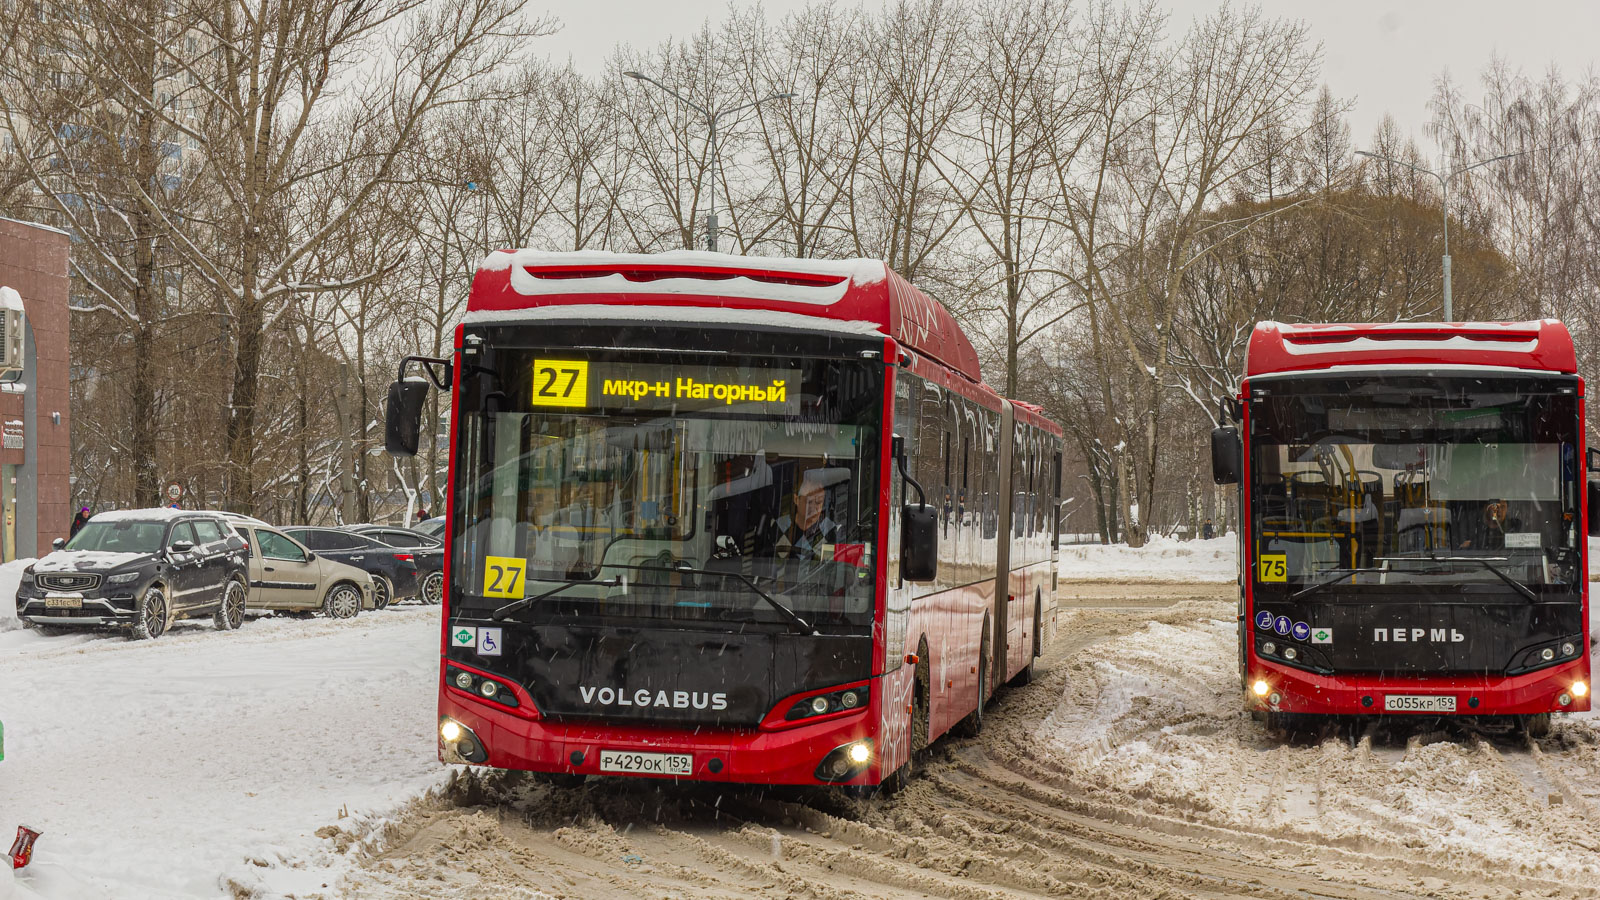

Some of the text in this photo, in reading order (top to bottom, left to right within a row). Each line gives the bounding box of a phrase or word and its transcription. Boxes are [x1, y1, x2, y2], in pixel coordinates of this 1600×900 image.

[538, 367, 580, 398] 27
[602, 377, 786, 405] мкр-н Нагорный
[1262, 560, 1285, 577] 75
[487, 565, 522, 594] 27
[1374, 628, 1465, 642] ПЕРМЬ
[579, 686, 728, 710] VOLGABUS
[1389, 697, 1454, 709] С055КР 159
[604, 754, 688, 771] Р429ОК 159
